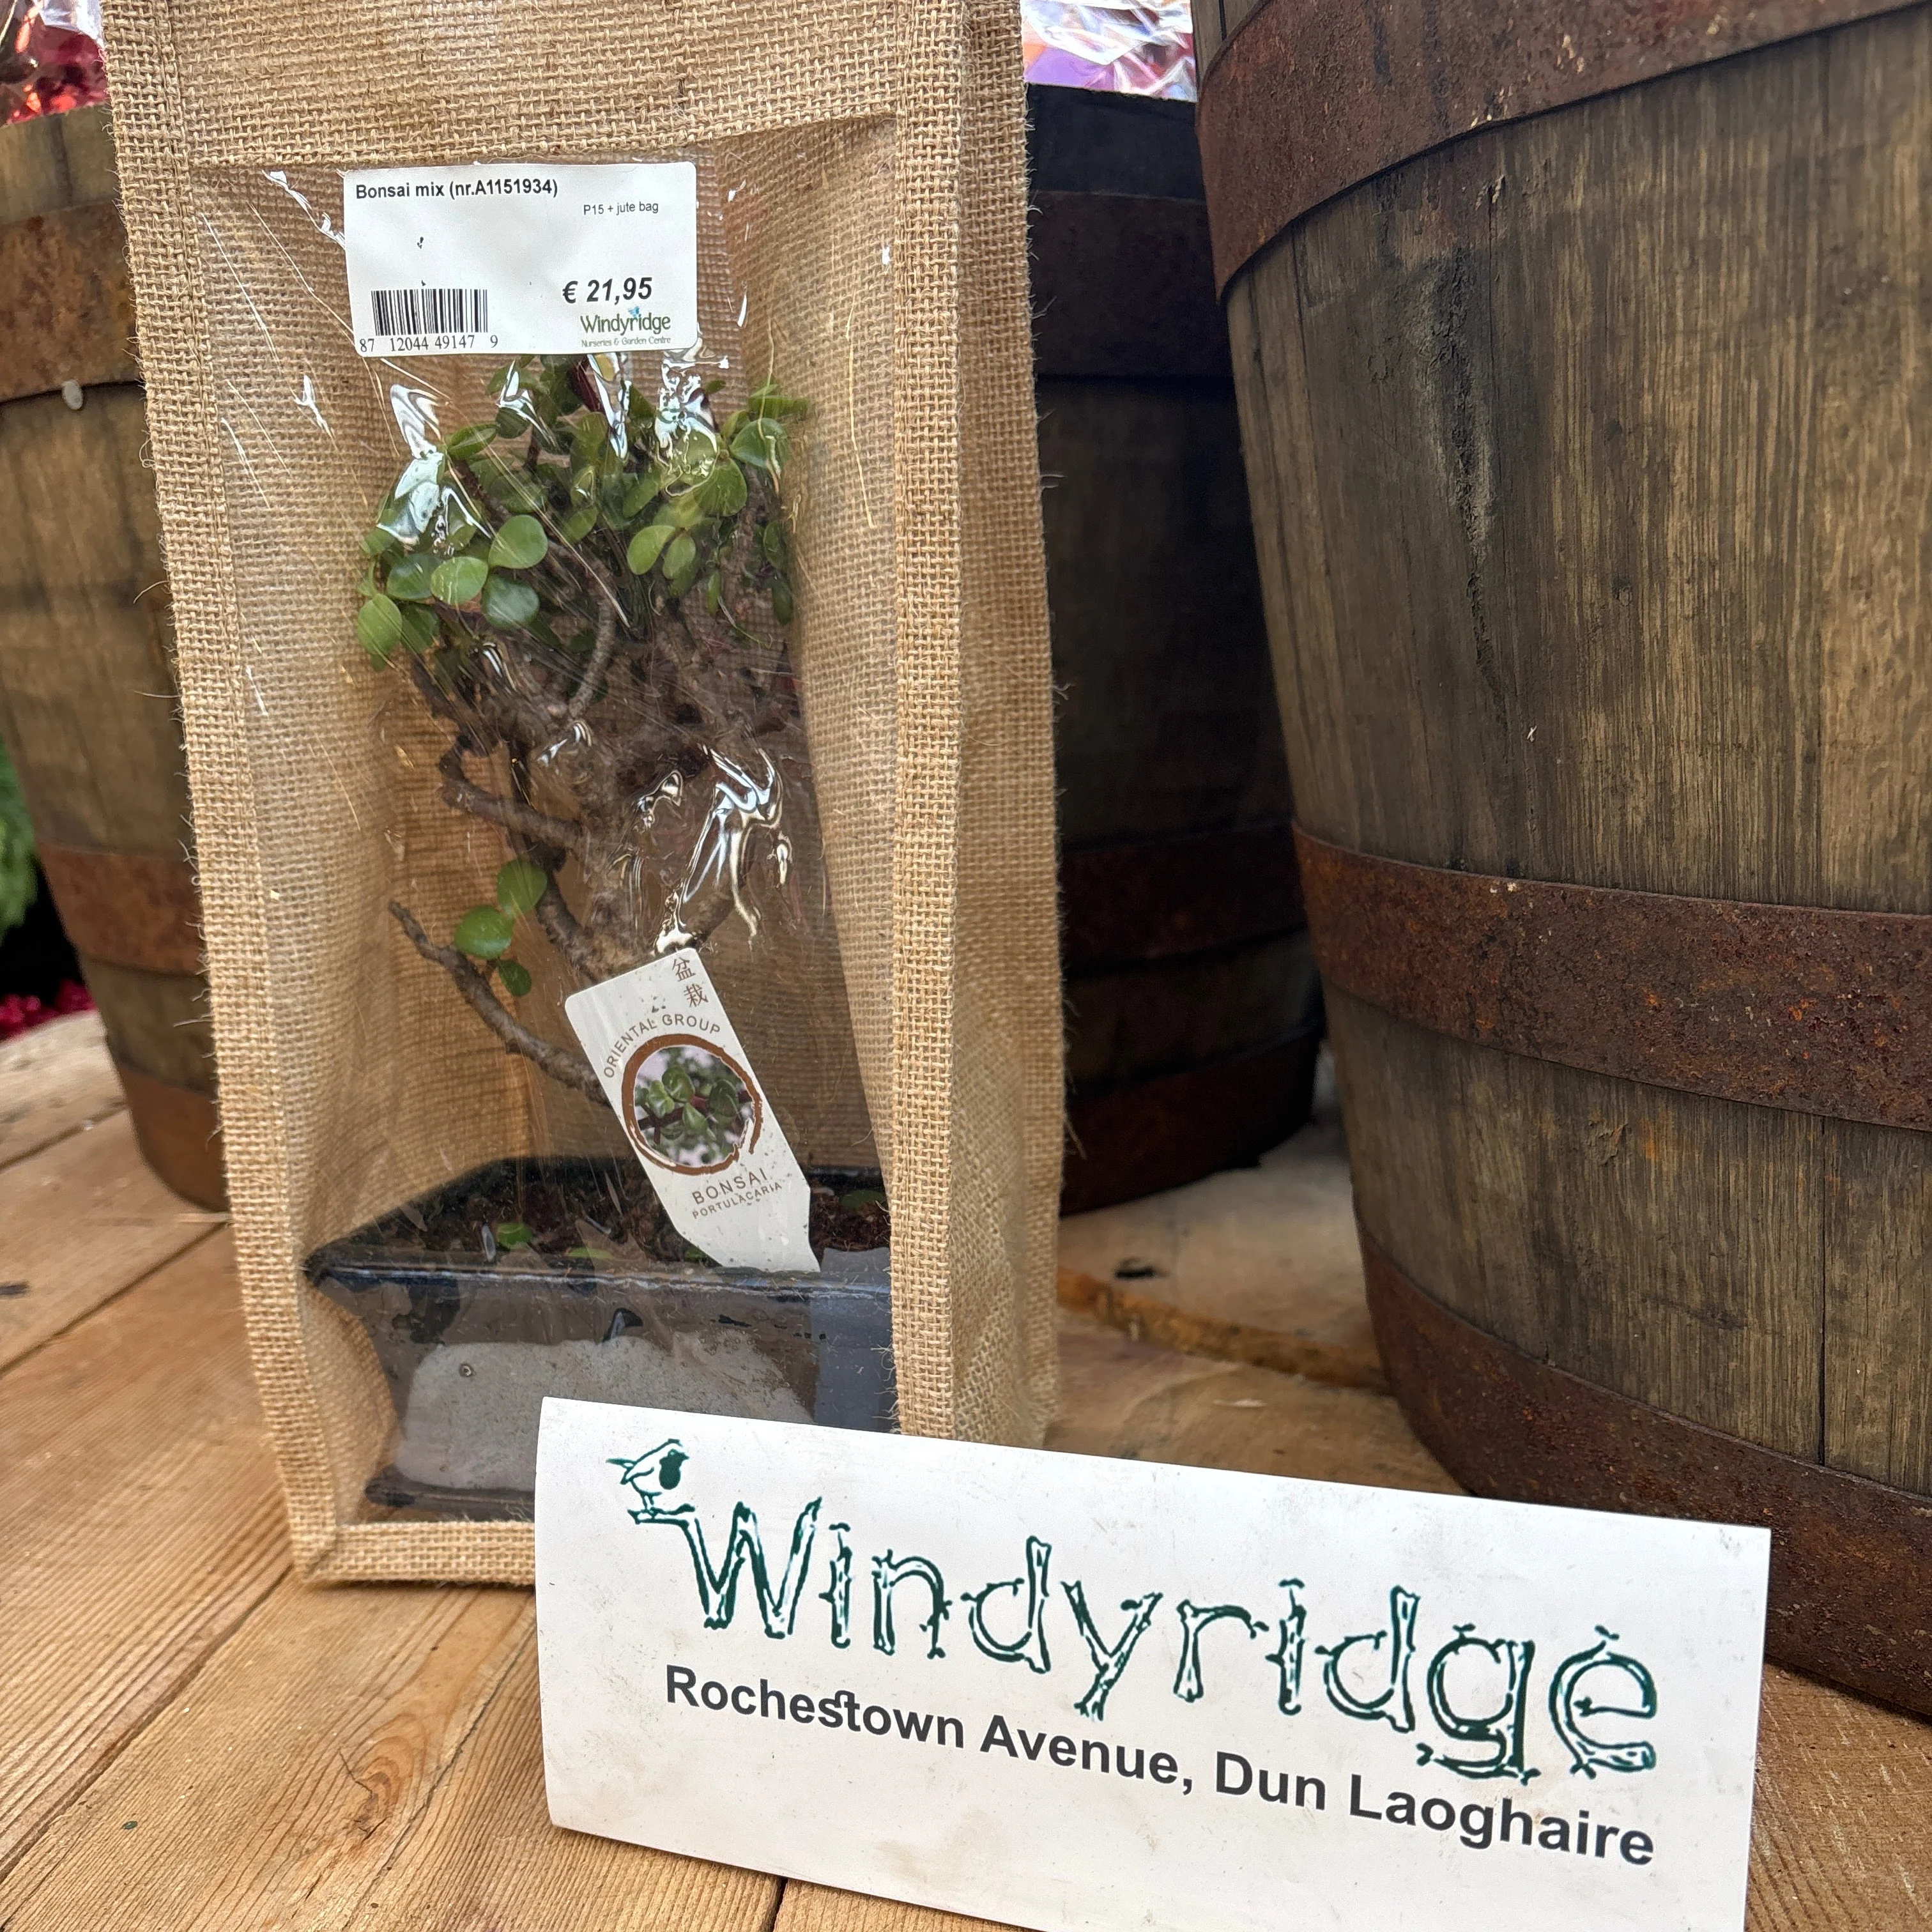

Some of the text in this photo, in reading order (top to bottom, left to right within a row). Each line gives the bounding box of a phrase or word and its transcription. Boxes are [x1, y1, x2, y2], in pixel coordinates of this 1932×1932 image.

[356, 179, 558, 200] Bonsai mix (nr.A1151934)
[583, 203, 604, 215] P15
[616, 201, 636, 216] jute
[639, 201, 659, 214] bag
[562, 277, 652, 305] € 21,95
[580, 312, 671, 336] Windyridge
[359, 335, 498, 352] 87 12044 49147 9
[581, 339, 611, 348] Nurseries
[622, 337, 647, 345] Garden
[648, 335, 671, 344] Centre
[603, 1013, 721, 1078] ORIENTAL GROUP
[692, 1168, 767, 1205] BONSAI
[692, 1181, 783, 1220] PORTULACARIA
[627, 1494, 1656, 1785] Windyridge
[666, 1664, 1656, 1869] Rochestown Avenue, Dun Laoghaire
